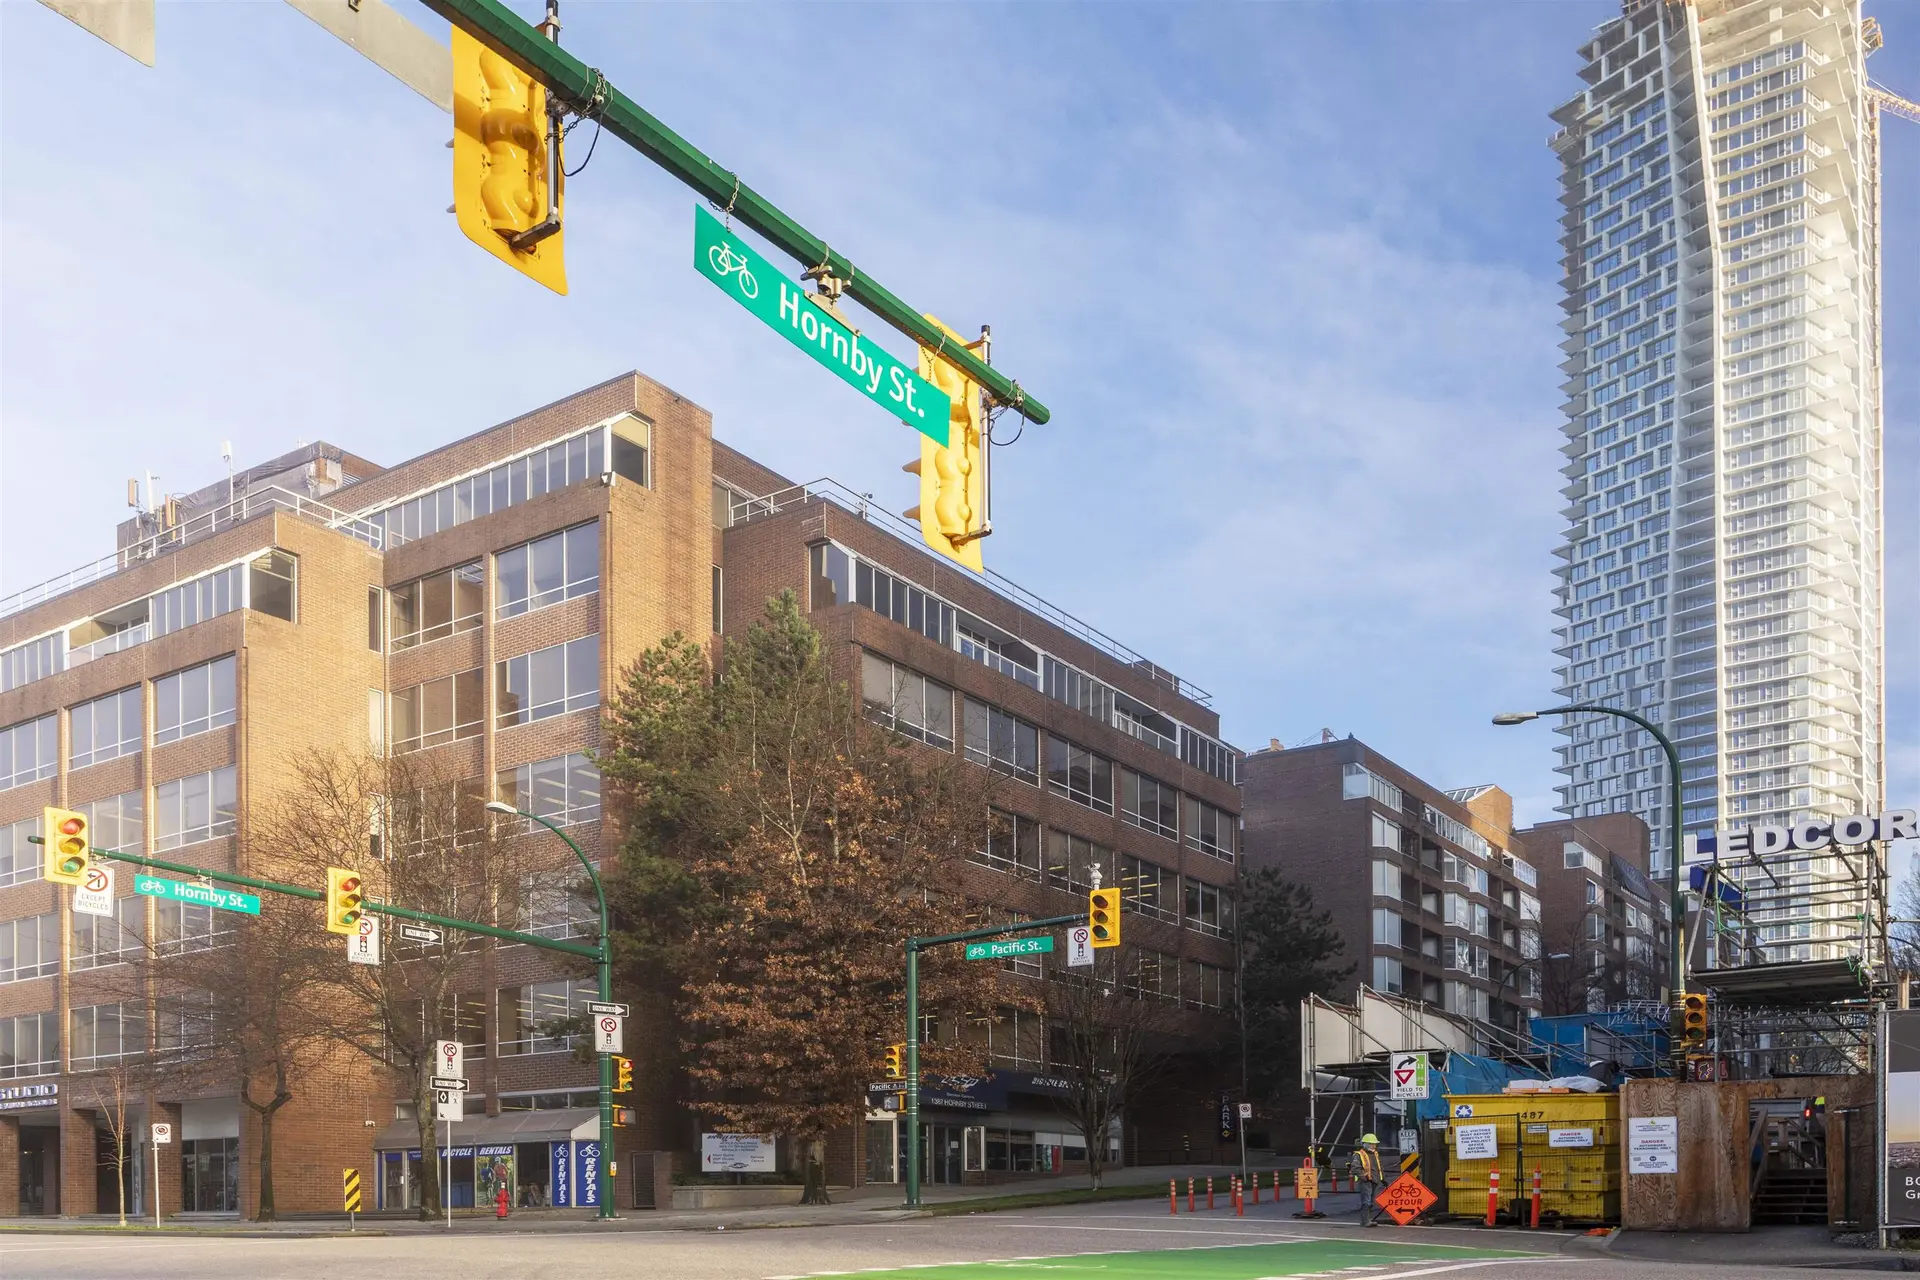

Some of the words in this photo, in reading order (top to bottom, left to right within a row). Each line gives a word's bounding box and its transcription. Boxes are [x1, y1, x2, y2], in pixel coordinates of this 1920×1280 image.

[779, 282, 883, 394] Hornby
[889, 366, 925, 418] St.
[1683, 808, 1920, 864] LEDCOR
[81, 893, 106, 903] EXCEPT
[174, 884, 226, 907] Hornby
[229, 895, 248, 909] St.
[78, 900, 109, 910] BICYCLES
[406, 929, 417, 937] ONE
[991, 942, 1026, 955] Pacific
[1027, 941, 1042, 952] St.
[0, 1083, 58, 1100] STUDIO
[871, 1083, 891, 1091] Pacific
[944, 1100, 967, 1108] HORNBY
[967, 1101, 987, 1109] STREET
[1222, 1095, 1230, 1129] PARK
[1521, 1111, 1544, 1119] 487
[441, 1147, 474, 1157] BCYCLE
[479, 1145, 513, 1156] RENTALS
[558, 1157, 567, 1204] RENTALS
[584, 1157, 597, 1204] RENTALS
[1388, 1198, 1423, 1207] DETOUR
